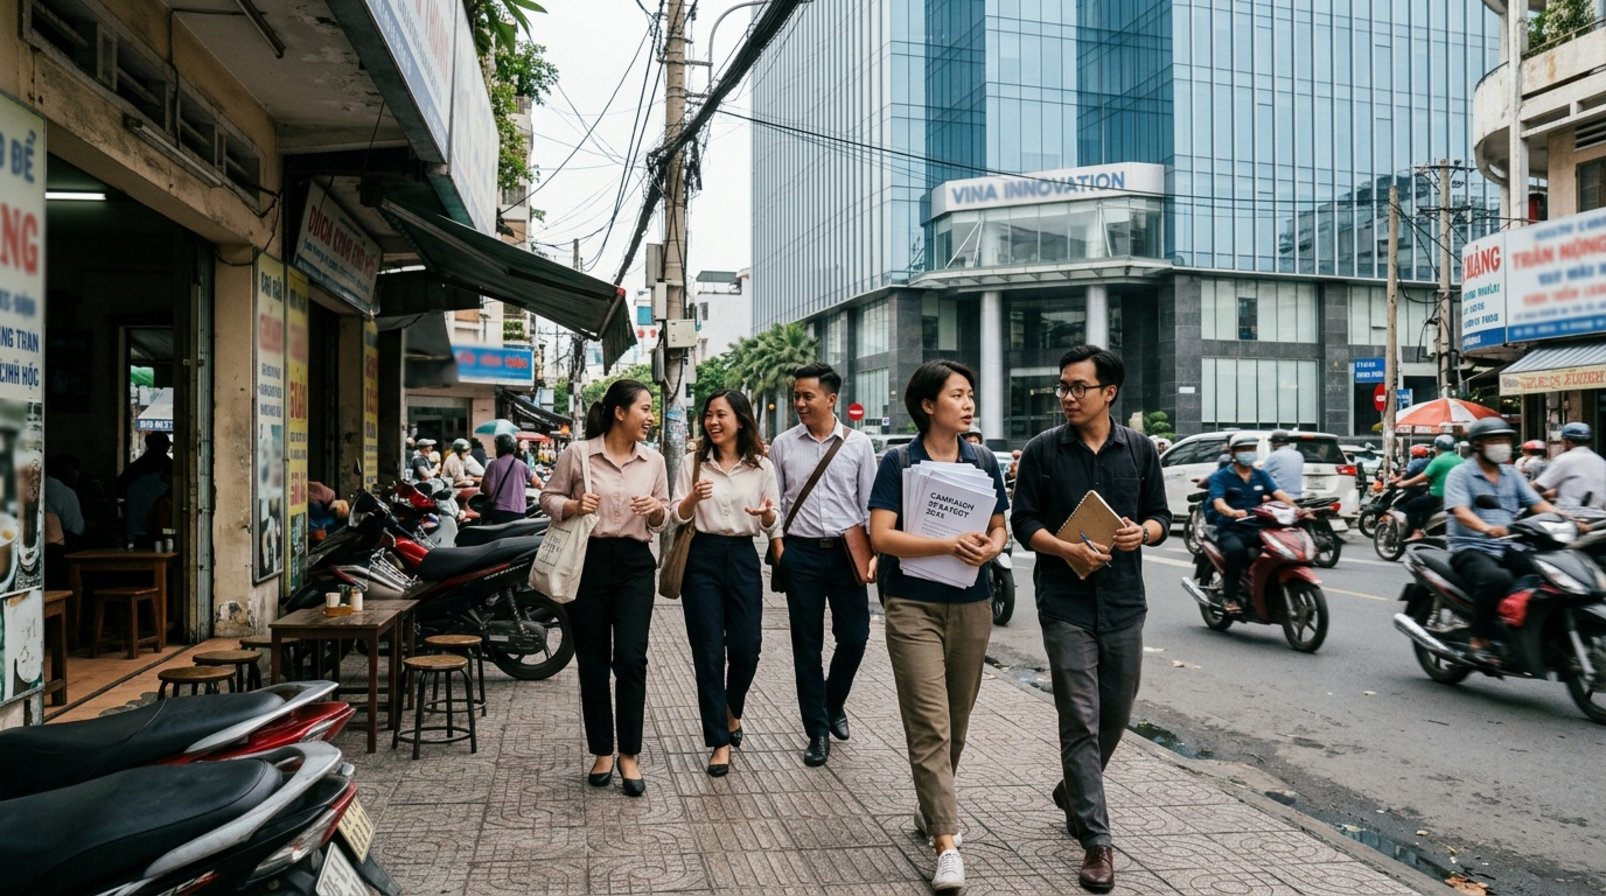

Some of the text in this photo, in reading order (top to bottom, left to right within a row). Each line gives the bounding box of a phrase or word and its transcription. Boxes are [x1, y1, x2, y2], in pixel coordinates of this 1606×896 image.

[952, 171, 1125, 205] VINA INNOVATION
[0, 202, 38, 276] NG
